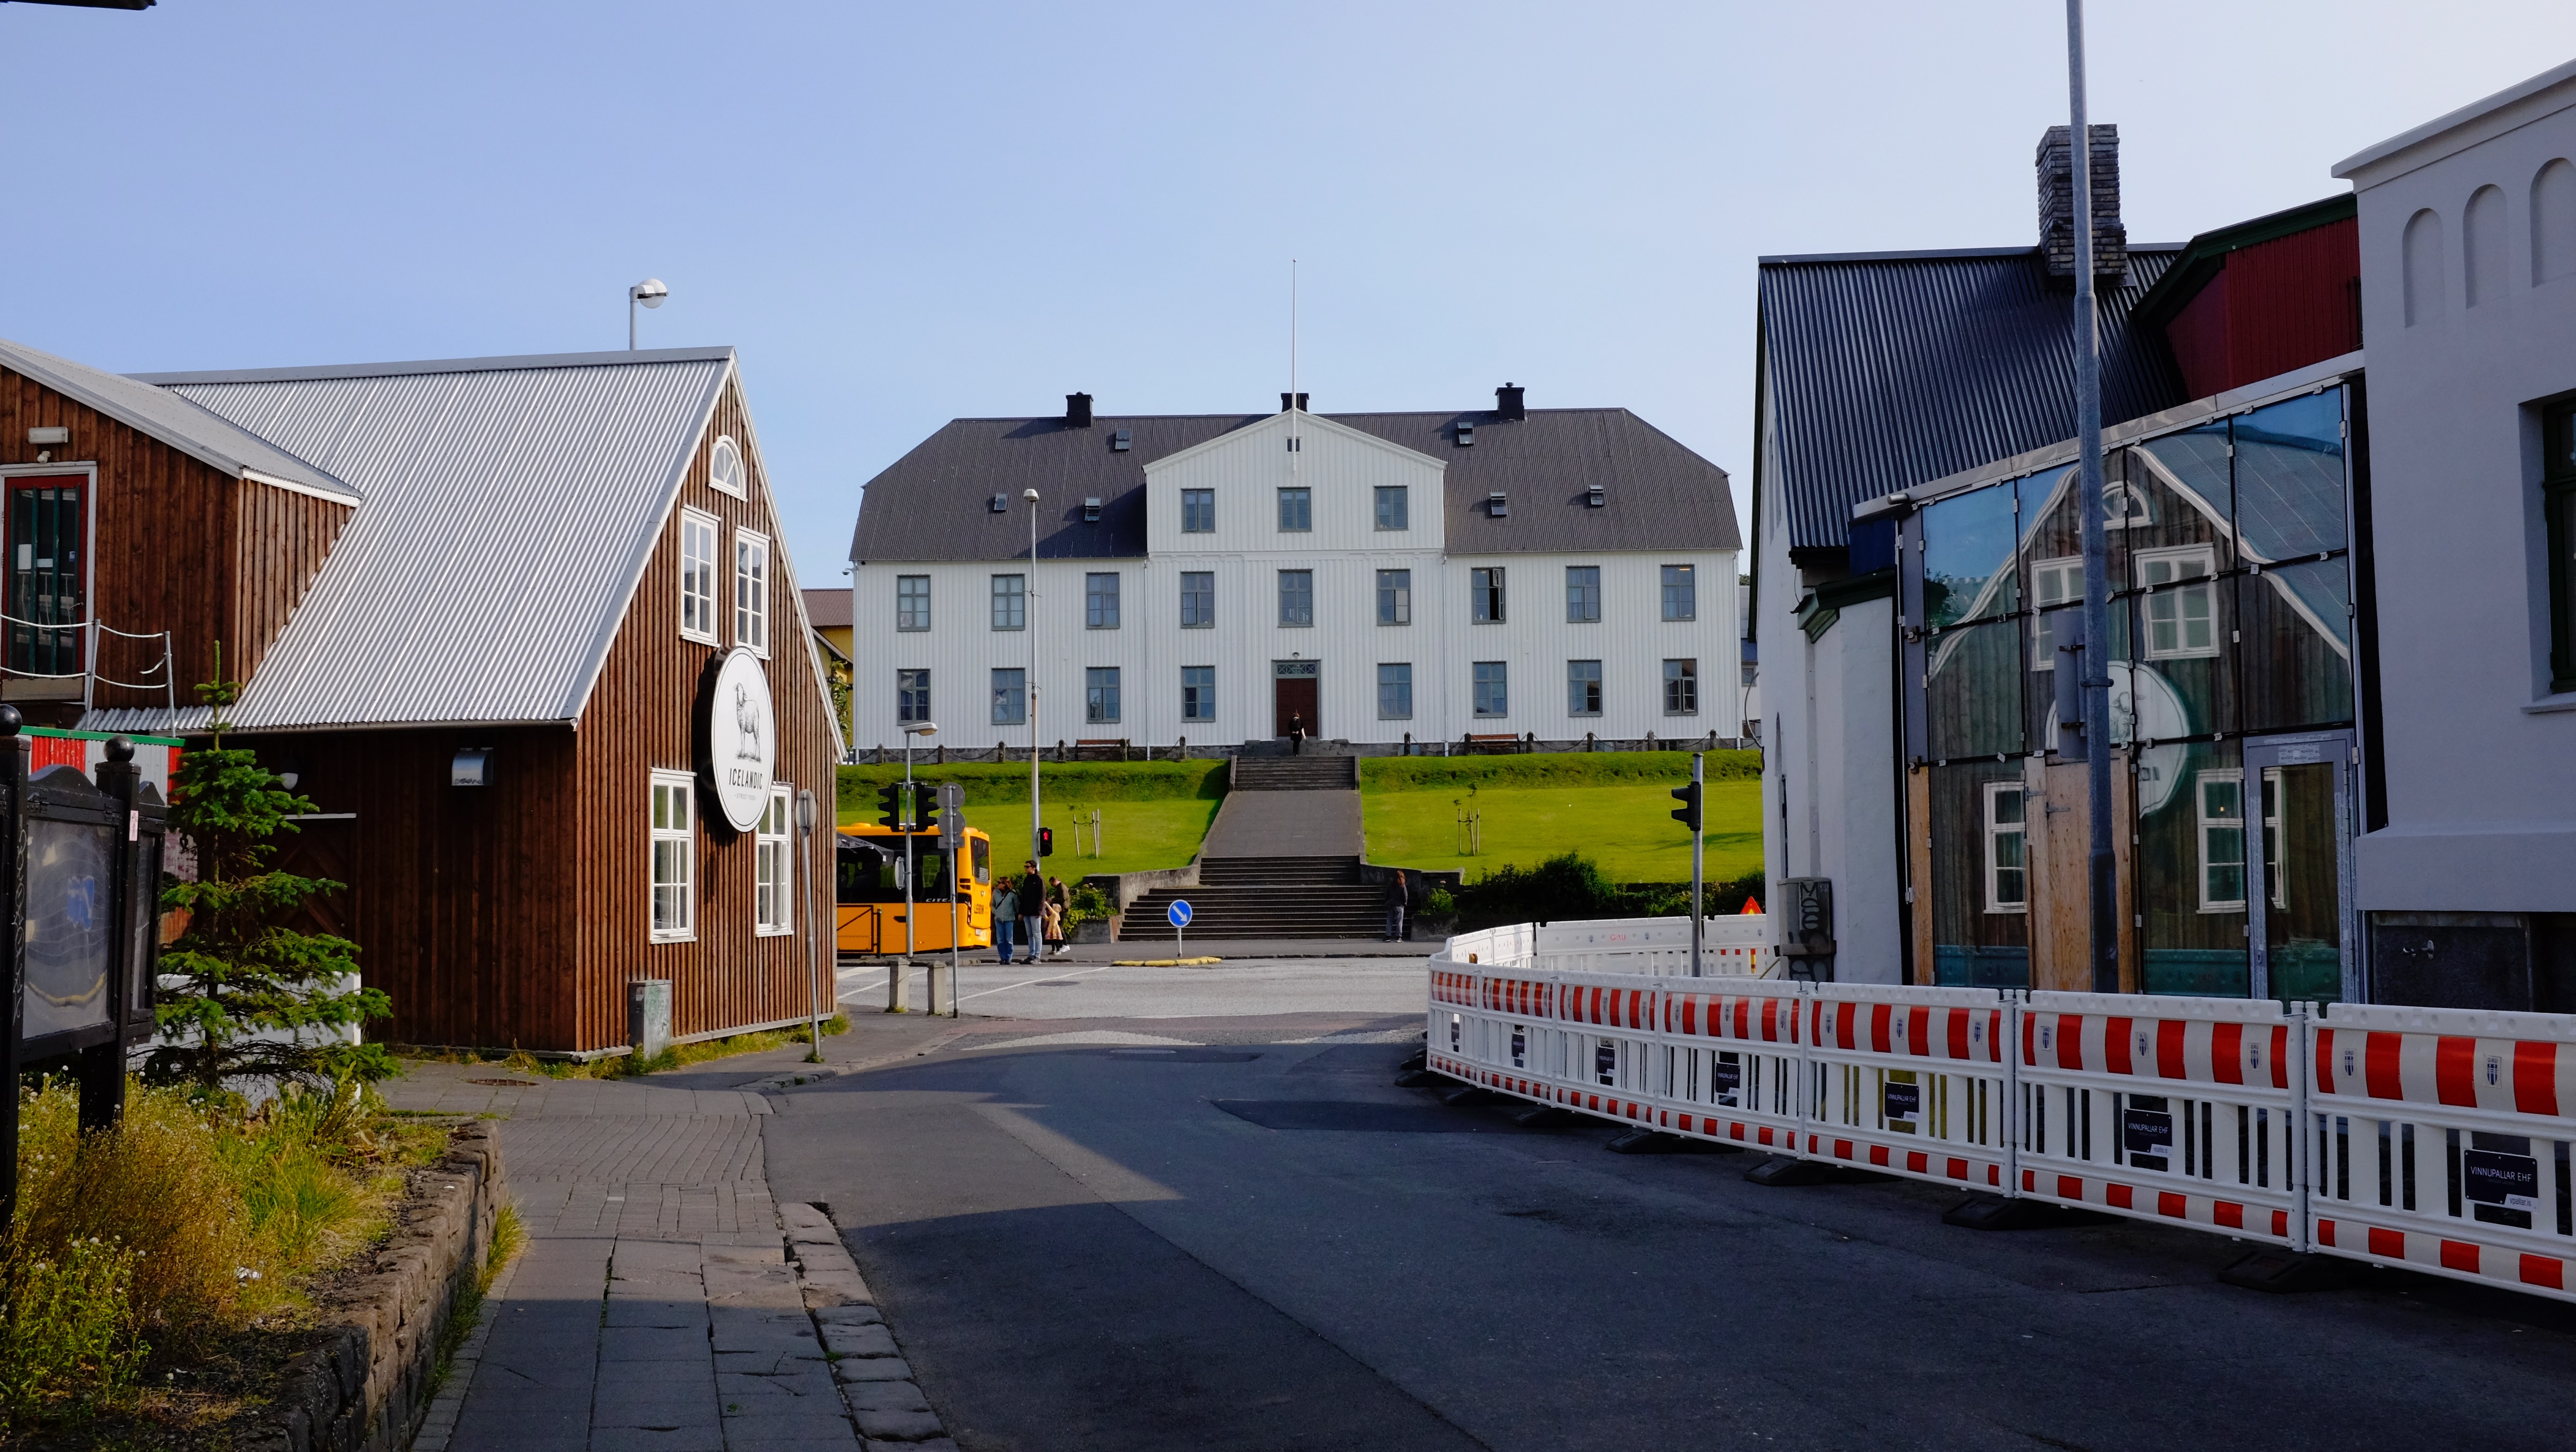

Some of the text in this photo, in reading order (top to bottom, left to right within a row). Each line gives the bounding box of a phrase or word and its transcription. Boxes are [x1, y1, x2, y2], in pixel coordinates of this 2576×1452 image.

[729, 768, 762, 790] ICELANDIC
[2128, 1122, 2168, 1134] VINNUPALLAR EHF
[2470, 1166, 2515, 1180] VINNUPALLAR
[2517, 1172, 2532, 1182] EHF
[2509, 1197, 2532, 1207] vpallar.is
